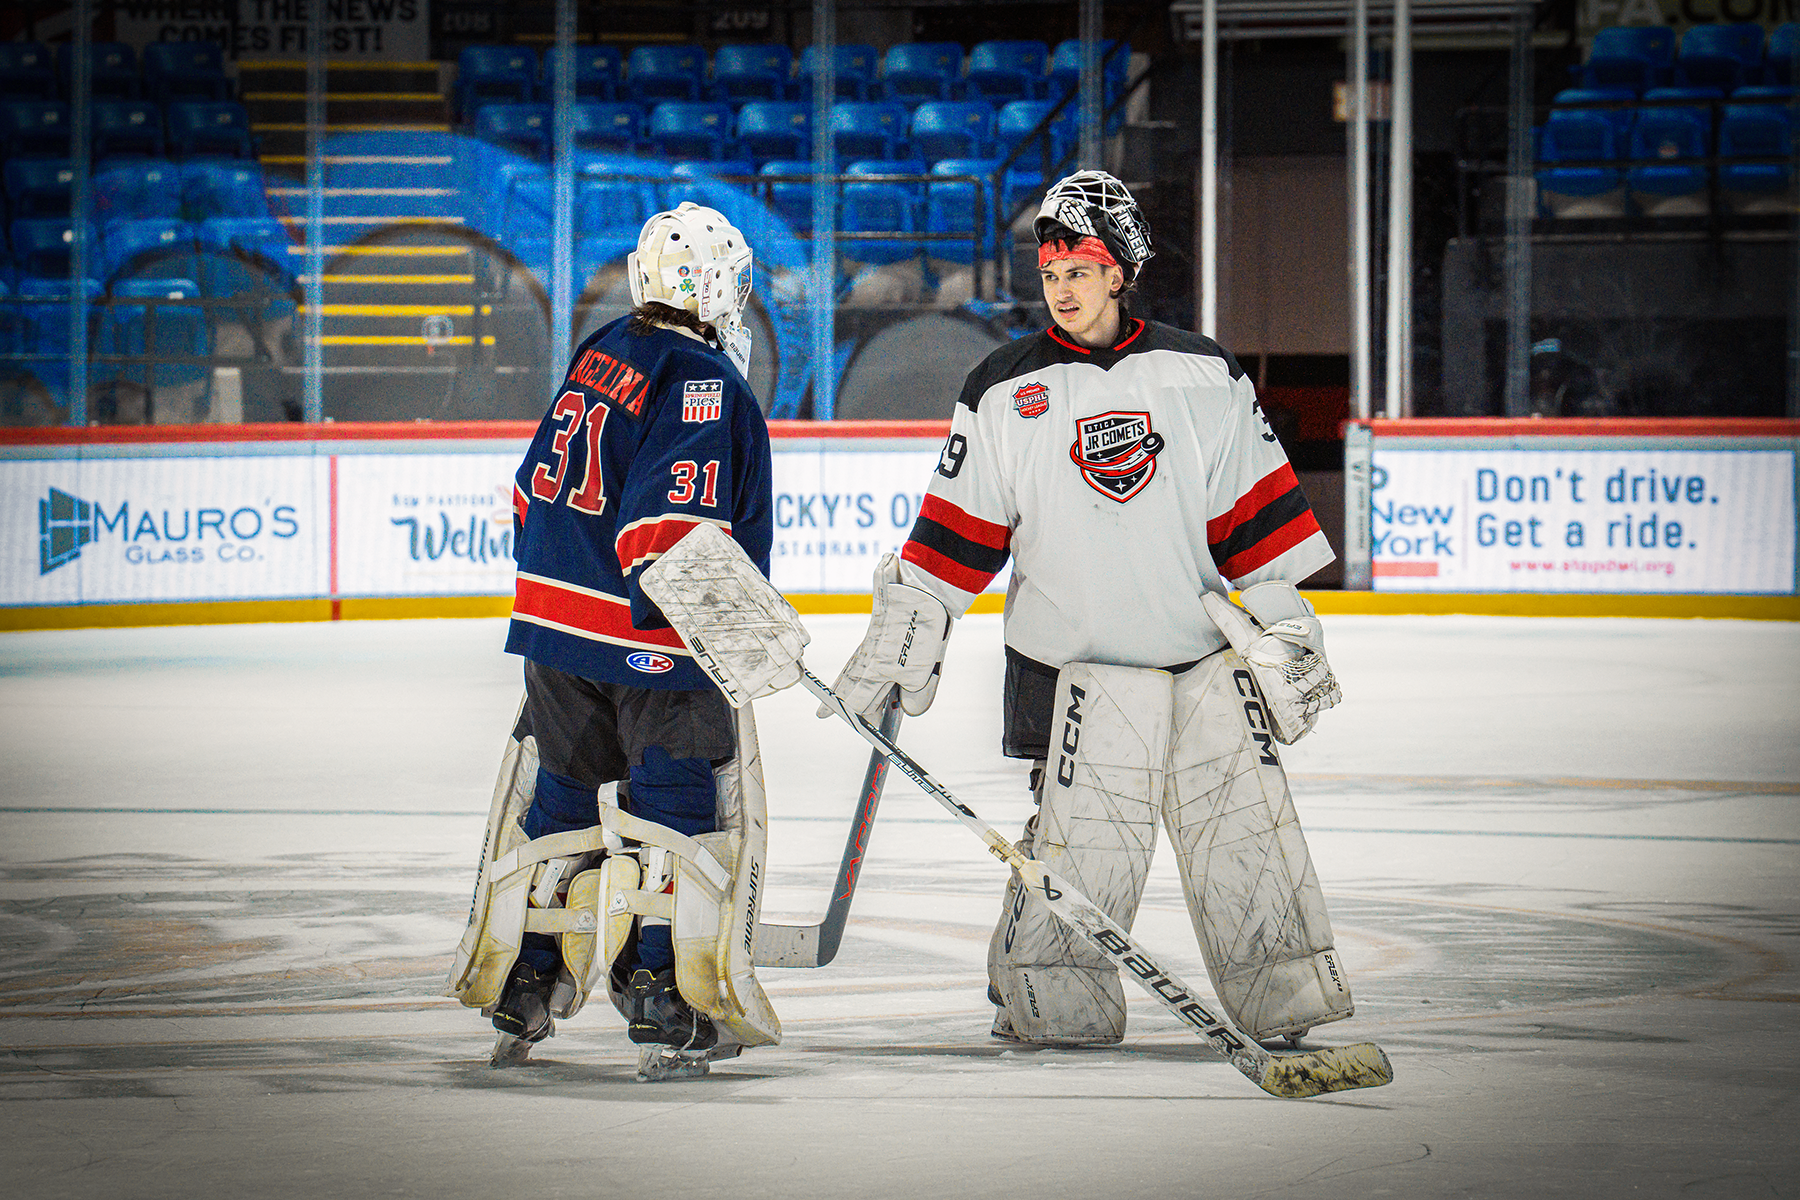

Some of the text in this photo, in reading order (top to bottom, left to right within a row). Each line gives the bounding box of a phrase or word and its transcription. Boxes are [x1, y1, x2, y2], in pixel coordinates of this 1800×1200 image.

[327, 0, 416, 21] NEWS
[160, 27, 383, 52] COMES FIST!
[690, 397, 716, 407] PICS
[1016, 392, 1048, 407] USPHL
[1085, 421, 1145, 451] JR COMETS
[1086, 419, 1116, 433] UTICA
[531, 390, 611, 516] 31
[934, 432, 967, 479] 9
[667, 460, 721, 508] 31
[1477, 467, 1719, 504] Don't drive.
[1372, 500, 1454, 525] New
[1477, 512, 1697, 549] Get a ride.
[773, 541, 880, 557] STAURANT
[1372, 529, 1454, 556] York
[897, 622, 916, 667] EFLEX
[689, 636, 738, 705] TRUE
[1057, 683, 1086, 788] CCM
[1232, 669, 1279, 766] CCM
[838, 762, 887, 901] VAPOR
[745, 856, 760, 956] SUPREME
[1005, 883, 1028, 954] CC
[1324, 954, 1341, 982] EFLEX
[1026, 982, 1040, 1018] EFLEX
